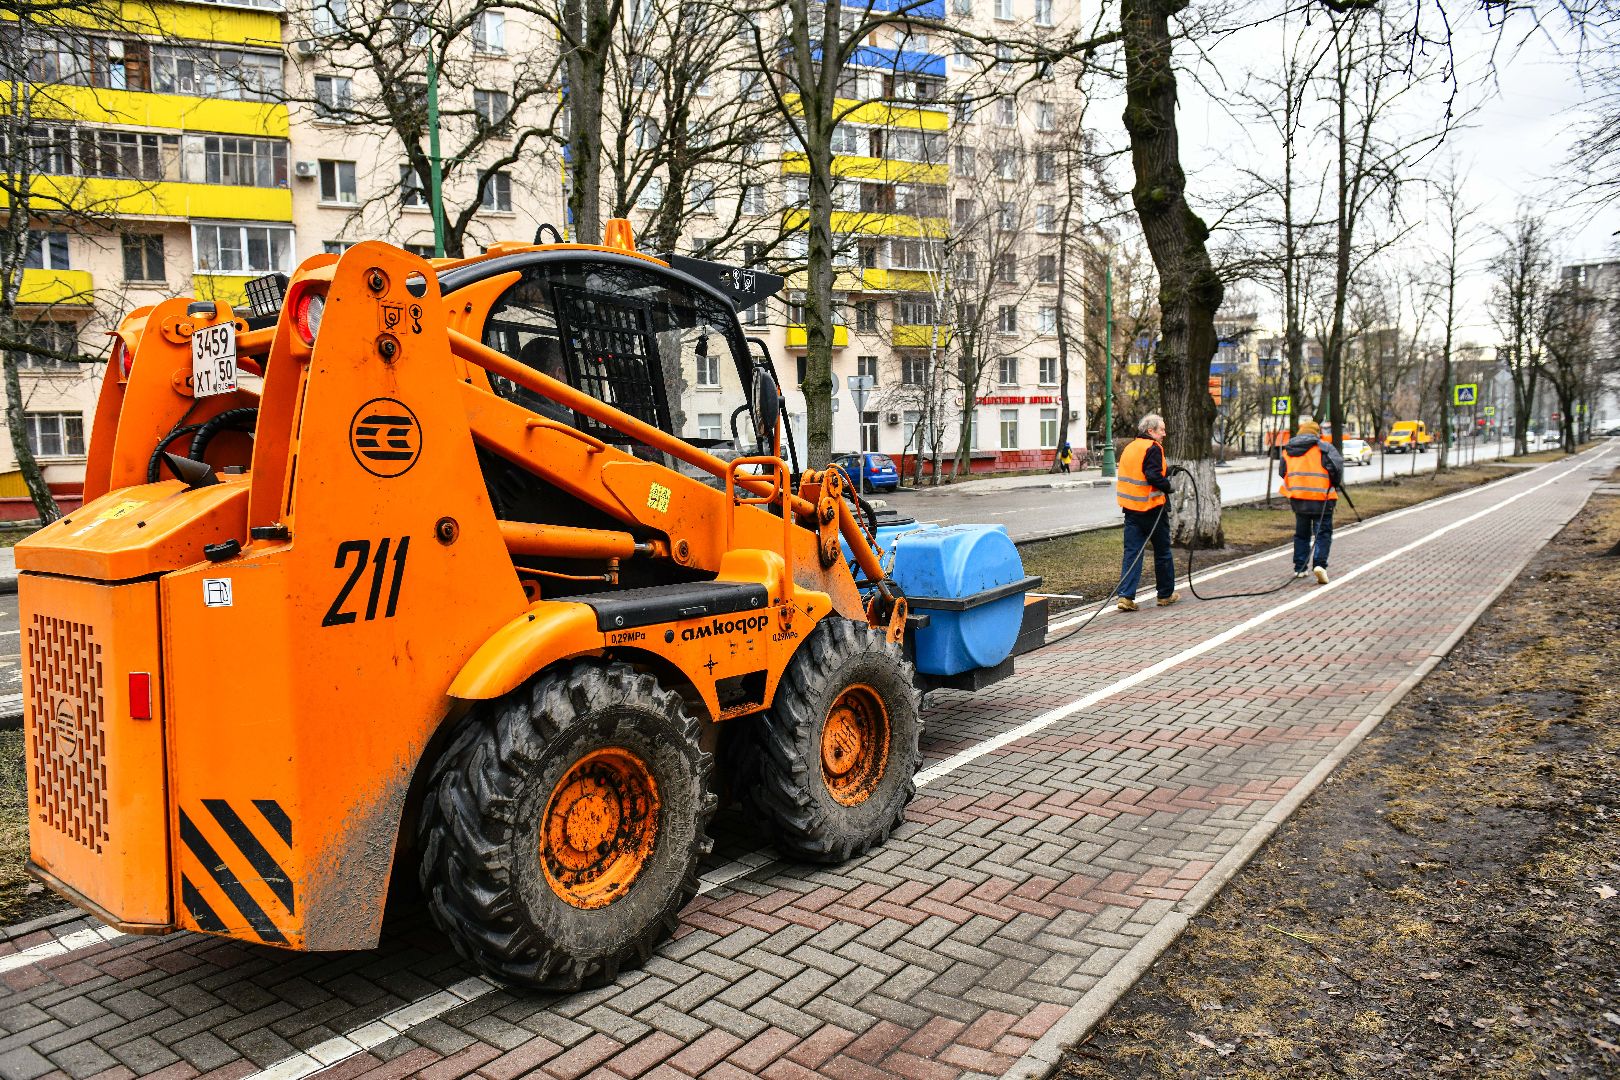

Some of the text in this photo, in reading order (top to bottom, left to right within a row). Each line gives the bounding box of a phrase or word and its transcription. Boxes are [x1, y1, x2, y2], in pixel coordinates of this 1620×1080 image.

[196, 327, 229, 359] 3459
[196, 360, 232, 393] ХТ 50
[321, 535, 411, 628] 211
